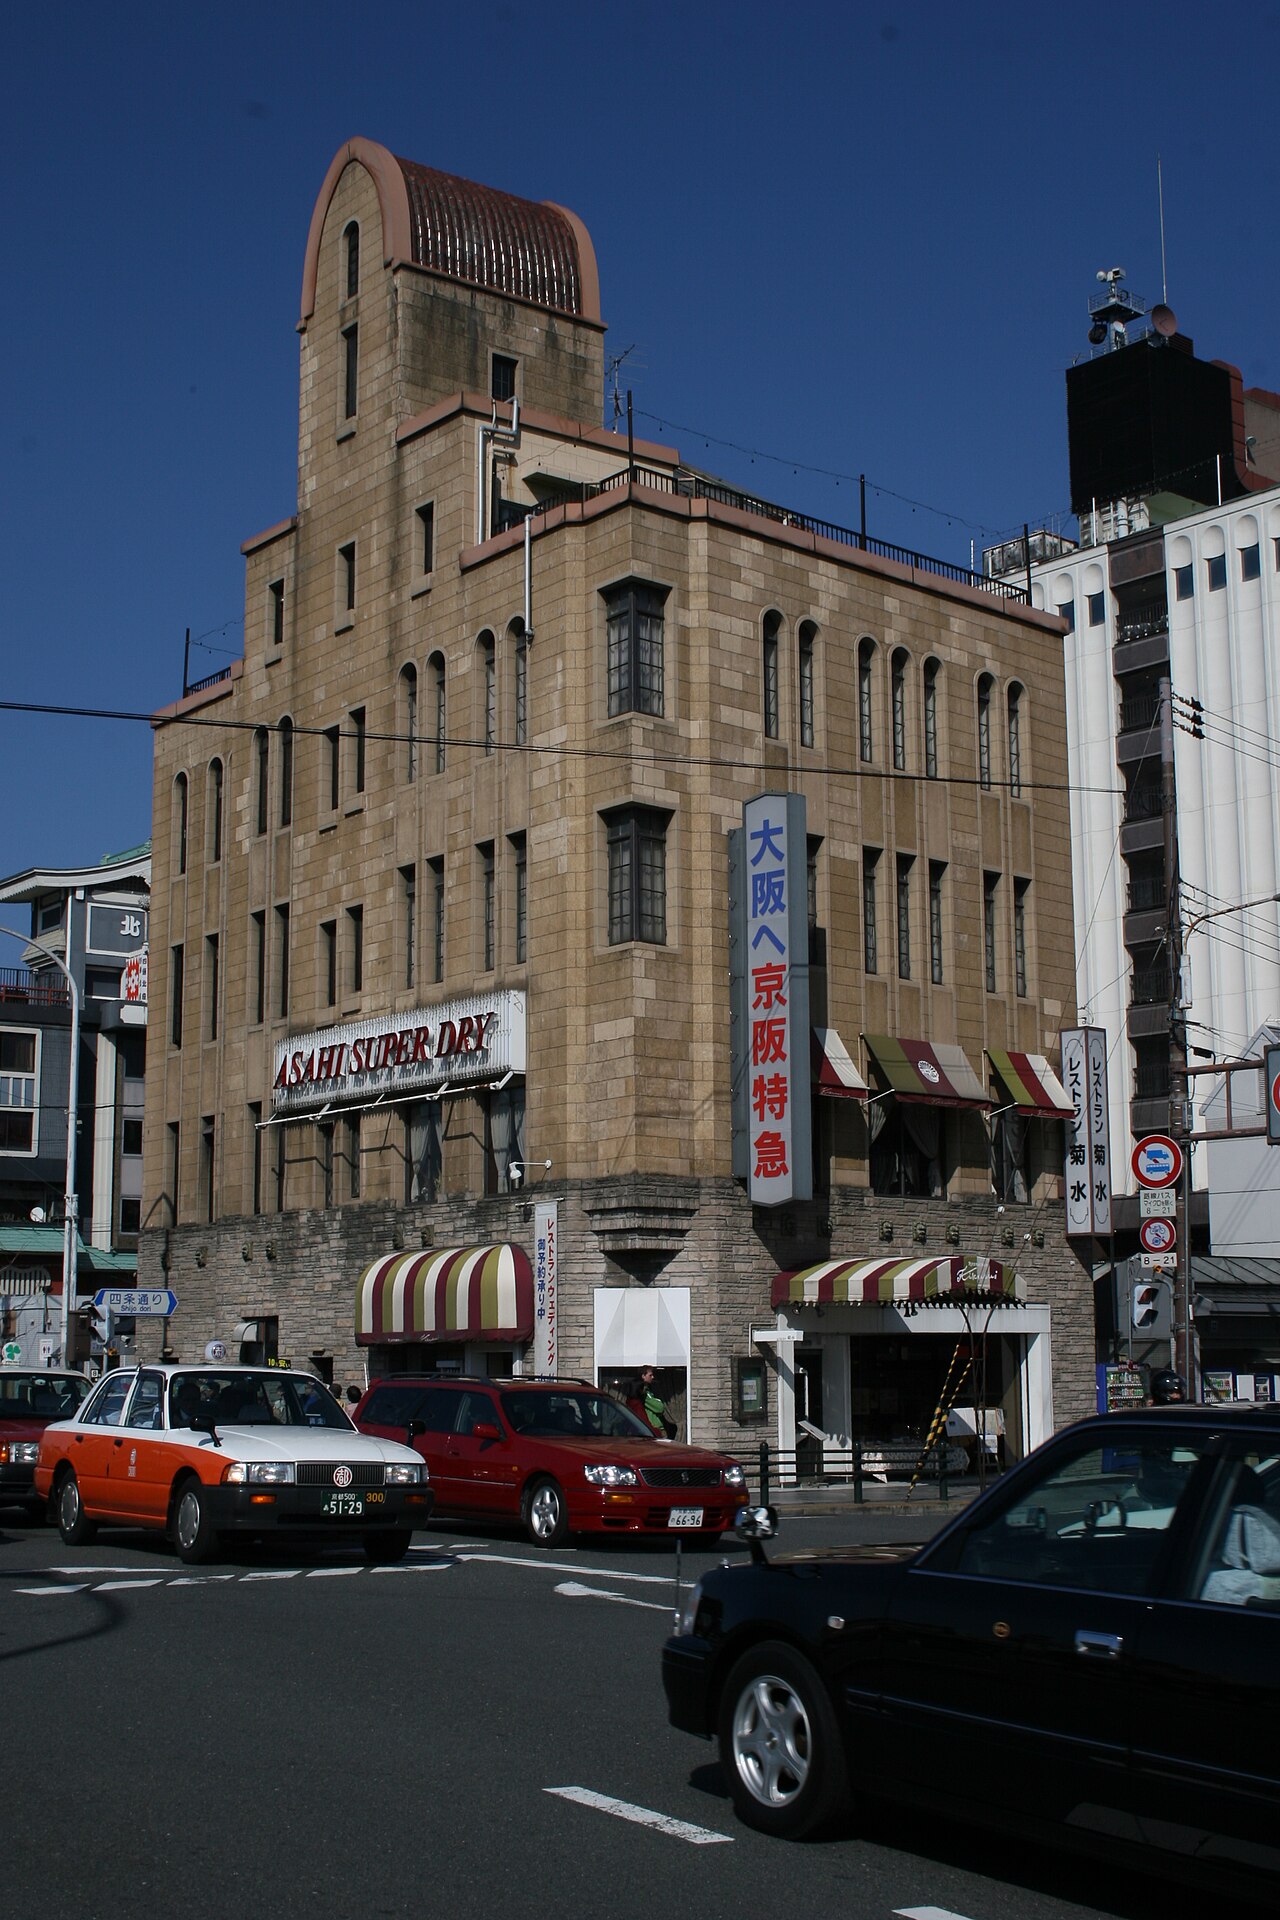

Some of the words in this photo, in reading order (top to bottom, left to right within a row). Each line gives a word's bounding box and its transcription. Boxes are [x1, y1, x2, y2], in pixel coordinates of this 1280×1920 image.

[120, 915, 141, 937] 北
[273, 1042, 347, 1090] ASAHI
[350, 1025, 430, 1075] SUPER
[434, 1011, 496, 1058] DRY
[537, 1238, 546, 1320] 御予約承り中
[547, 1218, 555, 1366] レストランウェディング
[109, 1293, 162, 1305] 四条通り
[120, 1305, 137, 1313] Shijo
[366, 1492, 384, 1503] 300
[330, 1501, 363, 1514] 51-29
[675, 1515, 701, 1526] 66-96
